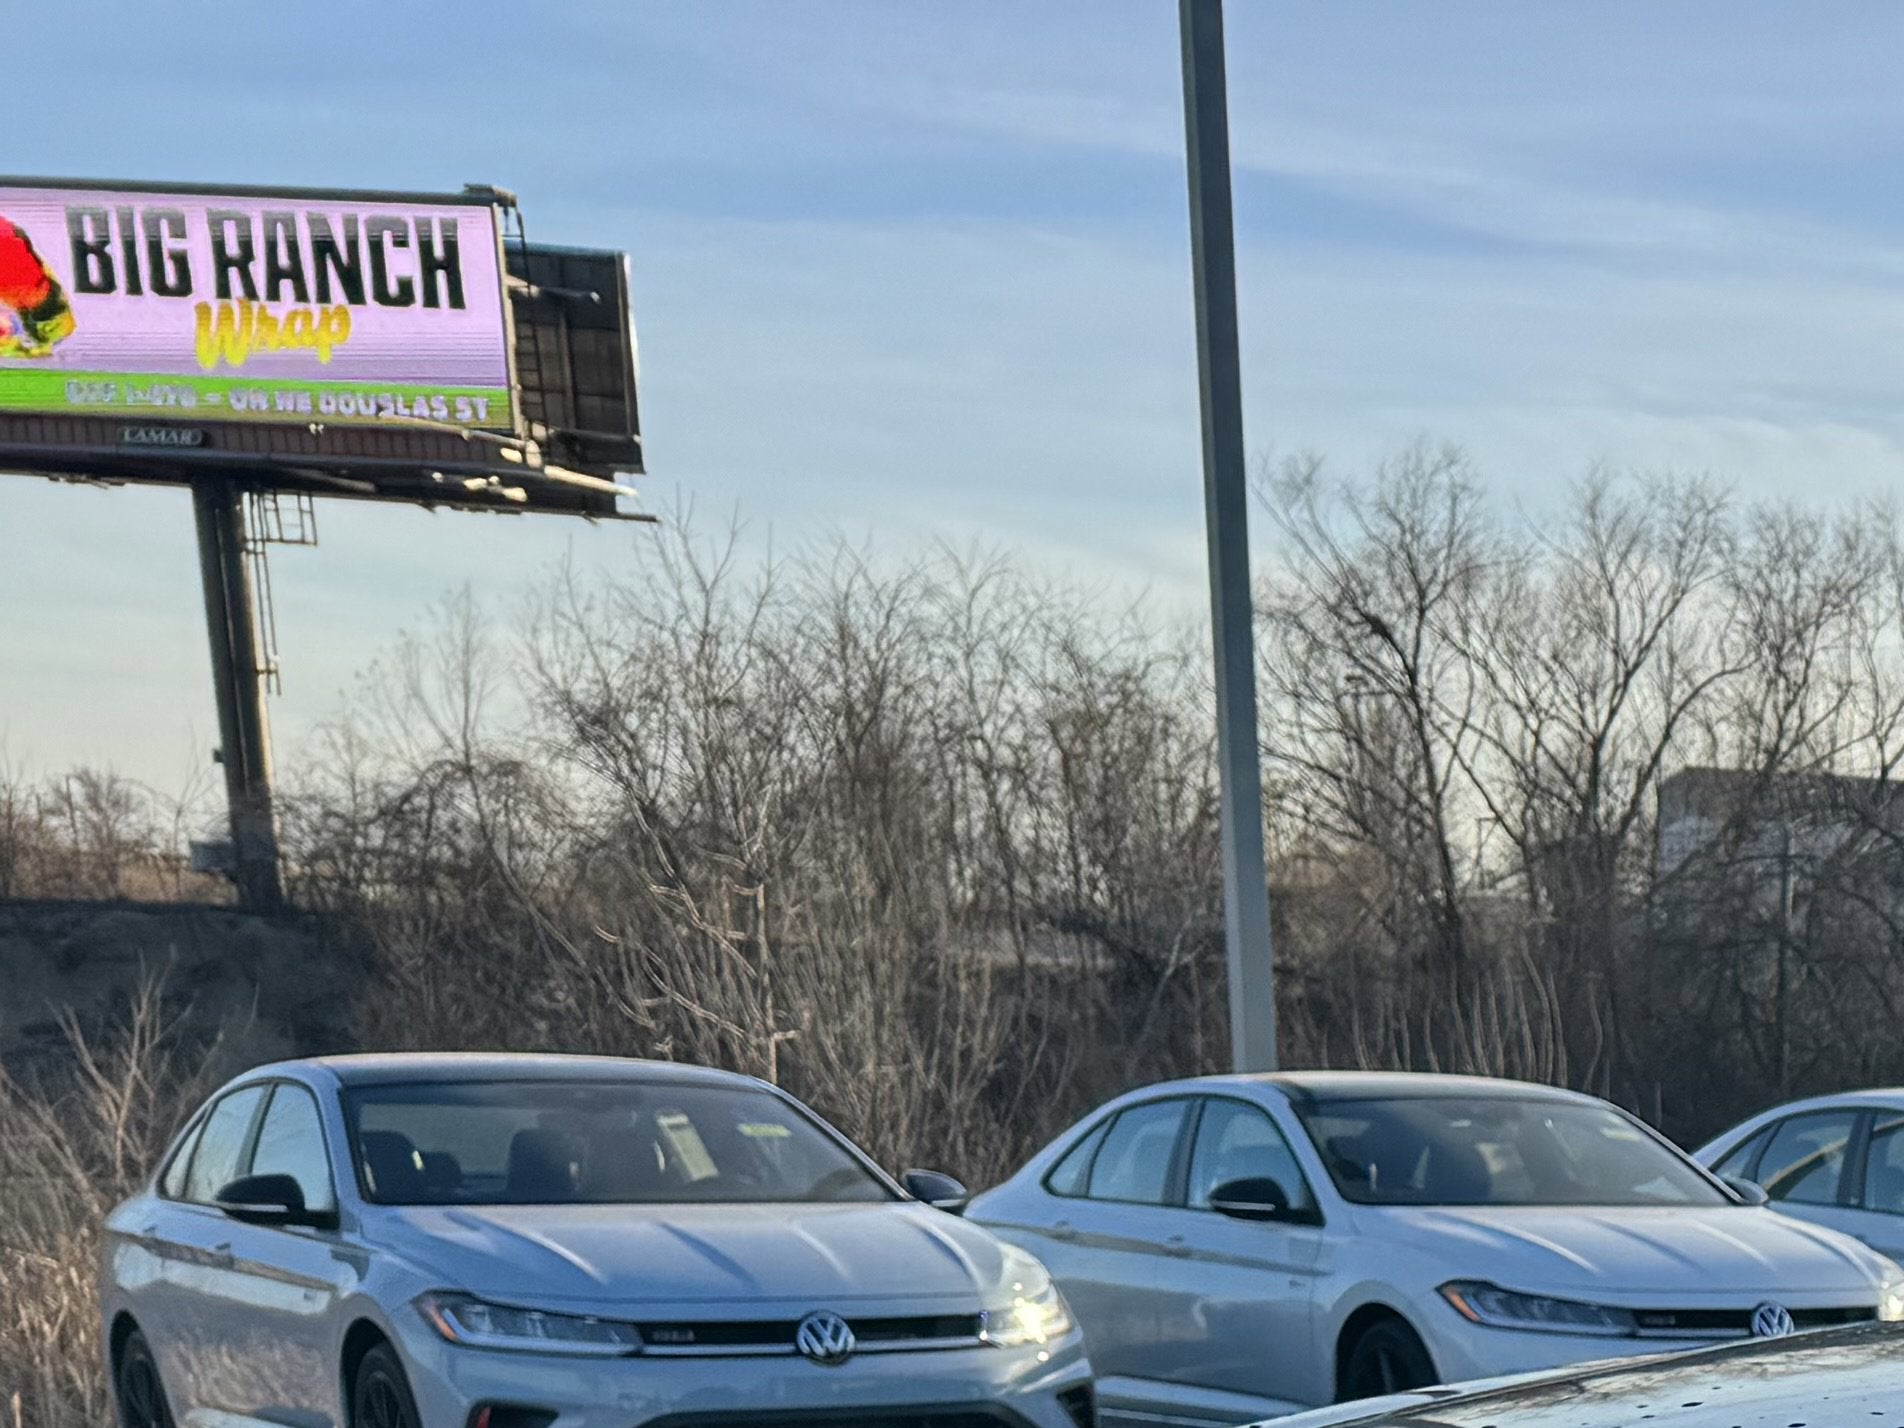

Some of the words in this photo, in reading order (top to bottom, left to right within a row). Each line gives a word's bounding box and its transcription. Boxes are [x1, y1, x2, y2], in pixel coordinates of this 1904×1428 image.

[64, 206, 193, 298] BIG
[206, 207, 467, 309] RANCH
[195, 296, 351, 369] Wrap
[455, 395, 489, 422] ST
[123, 426, 194, 445] LAMAR
